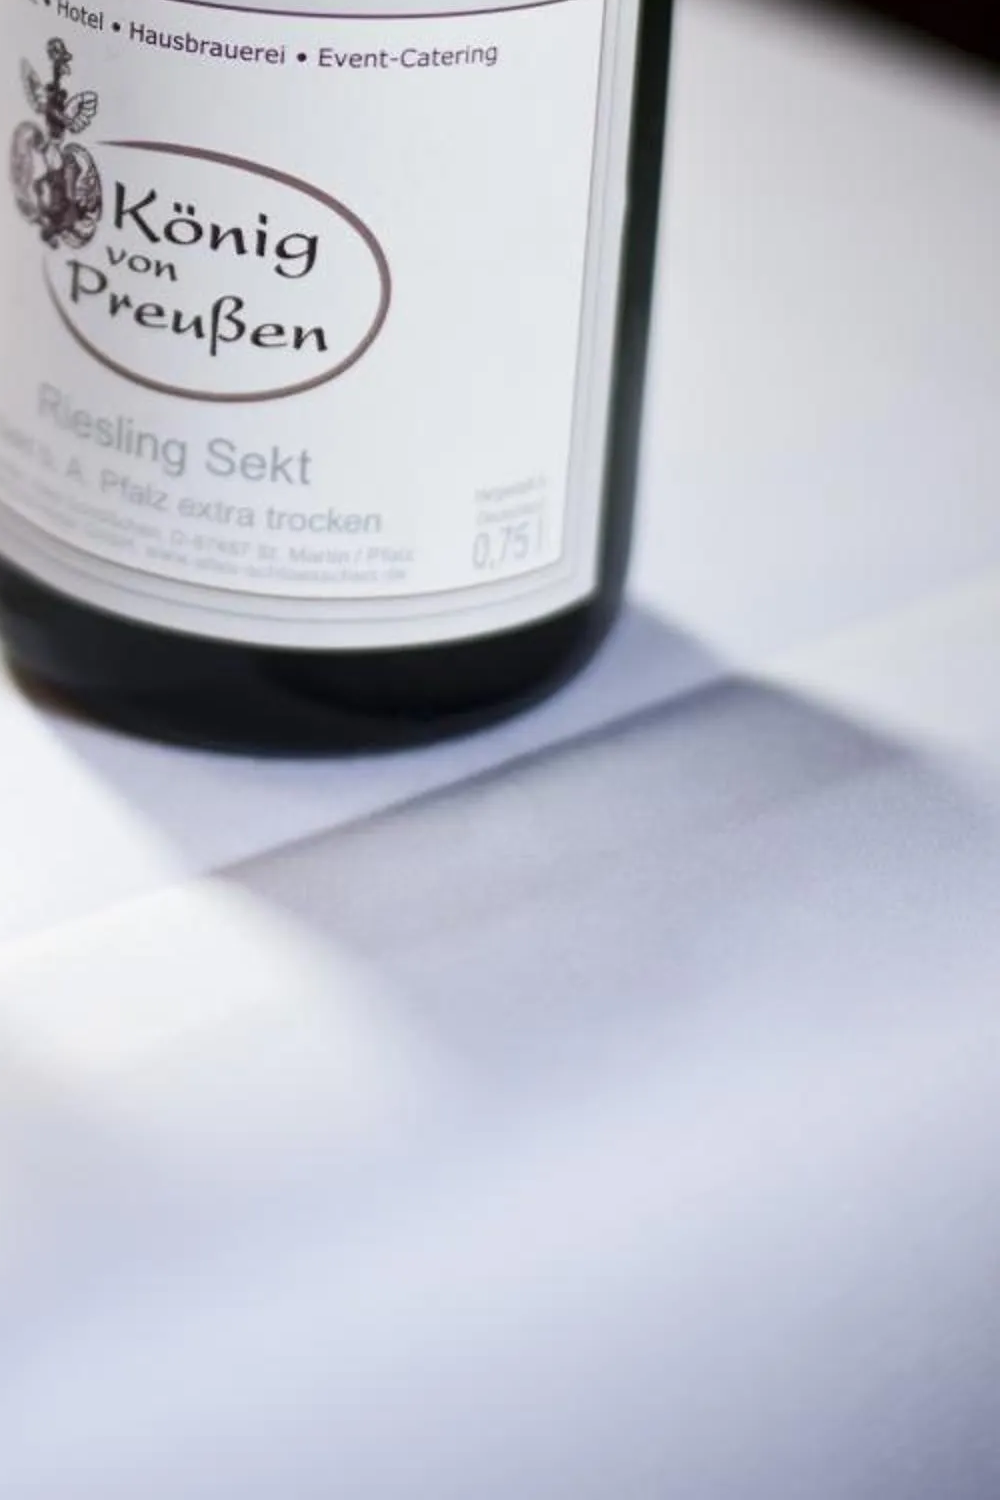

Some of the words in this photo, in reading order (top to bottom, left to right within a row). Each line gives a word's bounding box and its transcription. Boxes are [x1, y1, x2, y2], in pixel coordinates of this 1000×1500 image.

[129, 21, 285, 64] Hausbrauerei
[318, 44, 498, 68] Event-Catering
[106, 246, 177, 281] von
[114, 180, 318, 278] König
[66, 258, 328, 356] Preußen
[38, 381, 187, 477] Riesling
[205, 437, 312, 485] Sekt
[99, 467, 169, 512] Pfalz
[177, 497, 255, 528] extra
[266, 506, 382, 533] trocken
